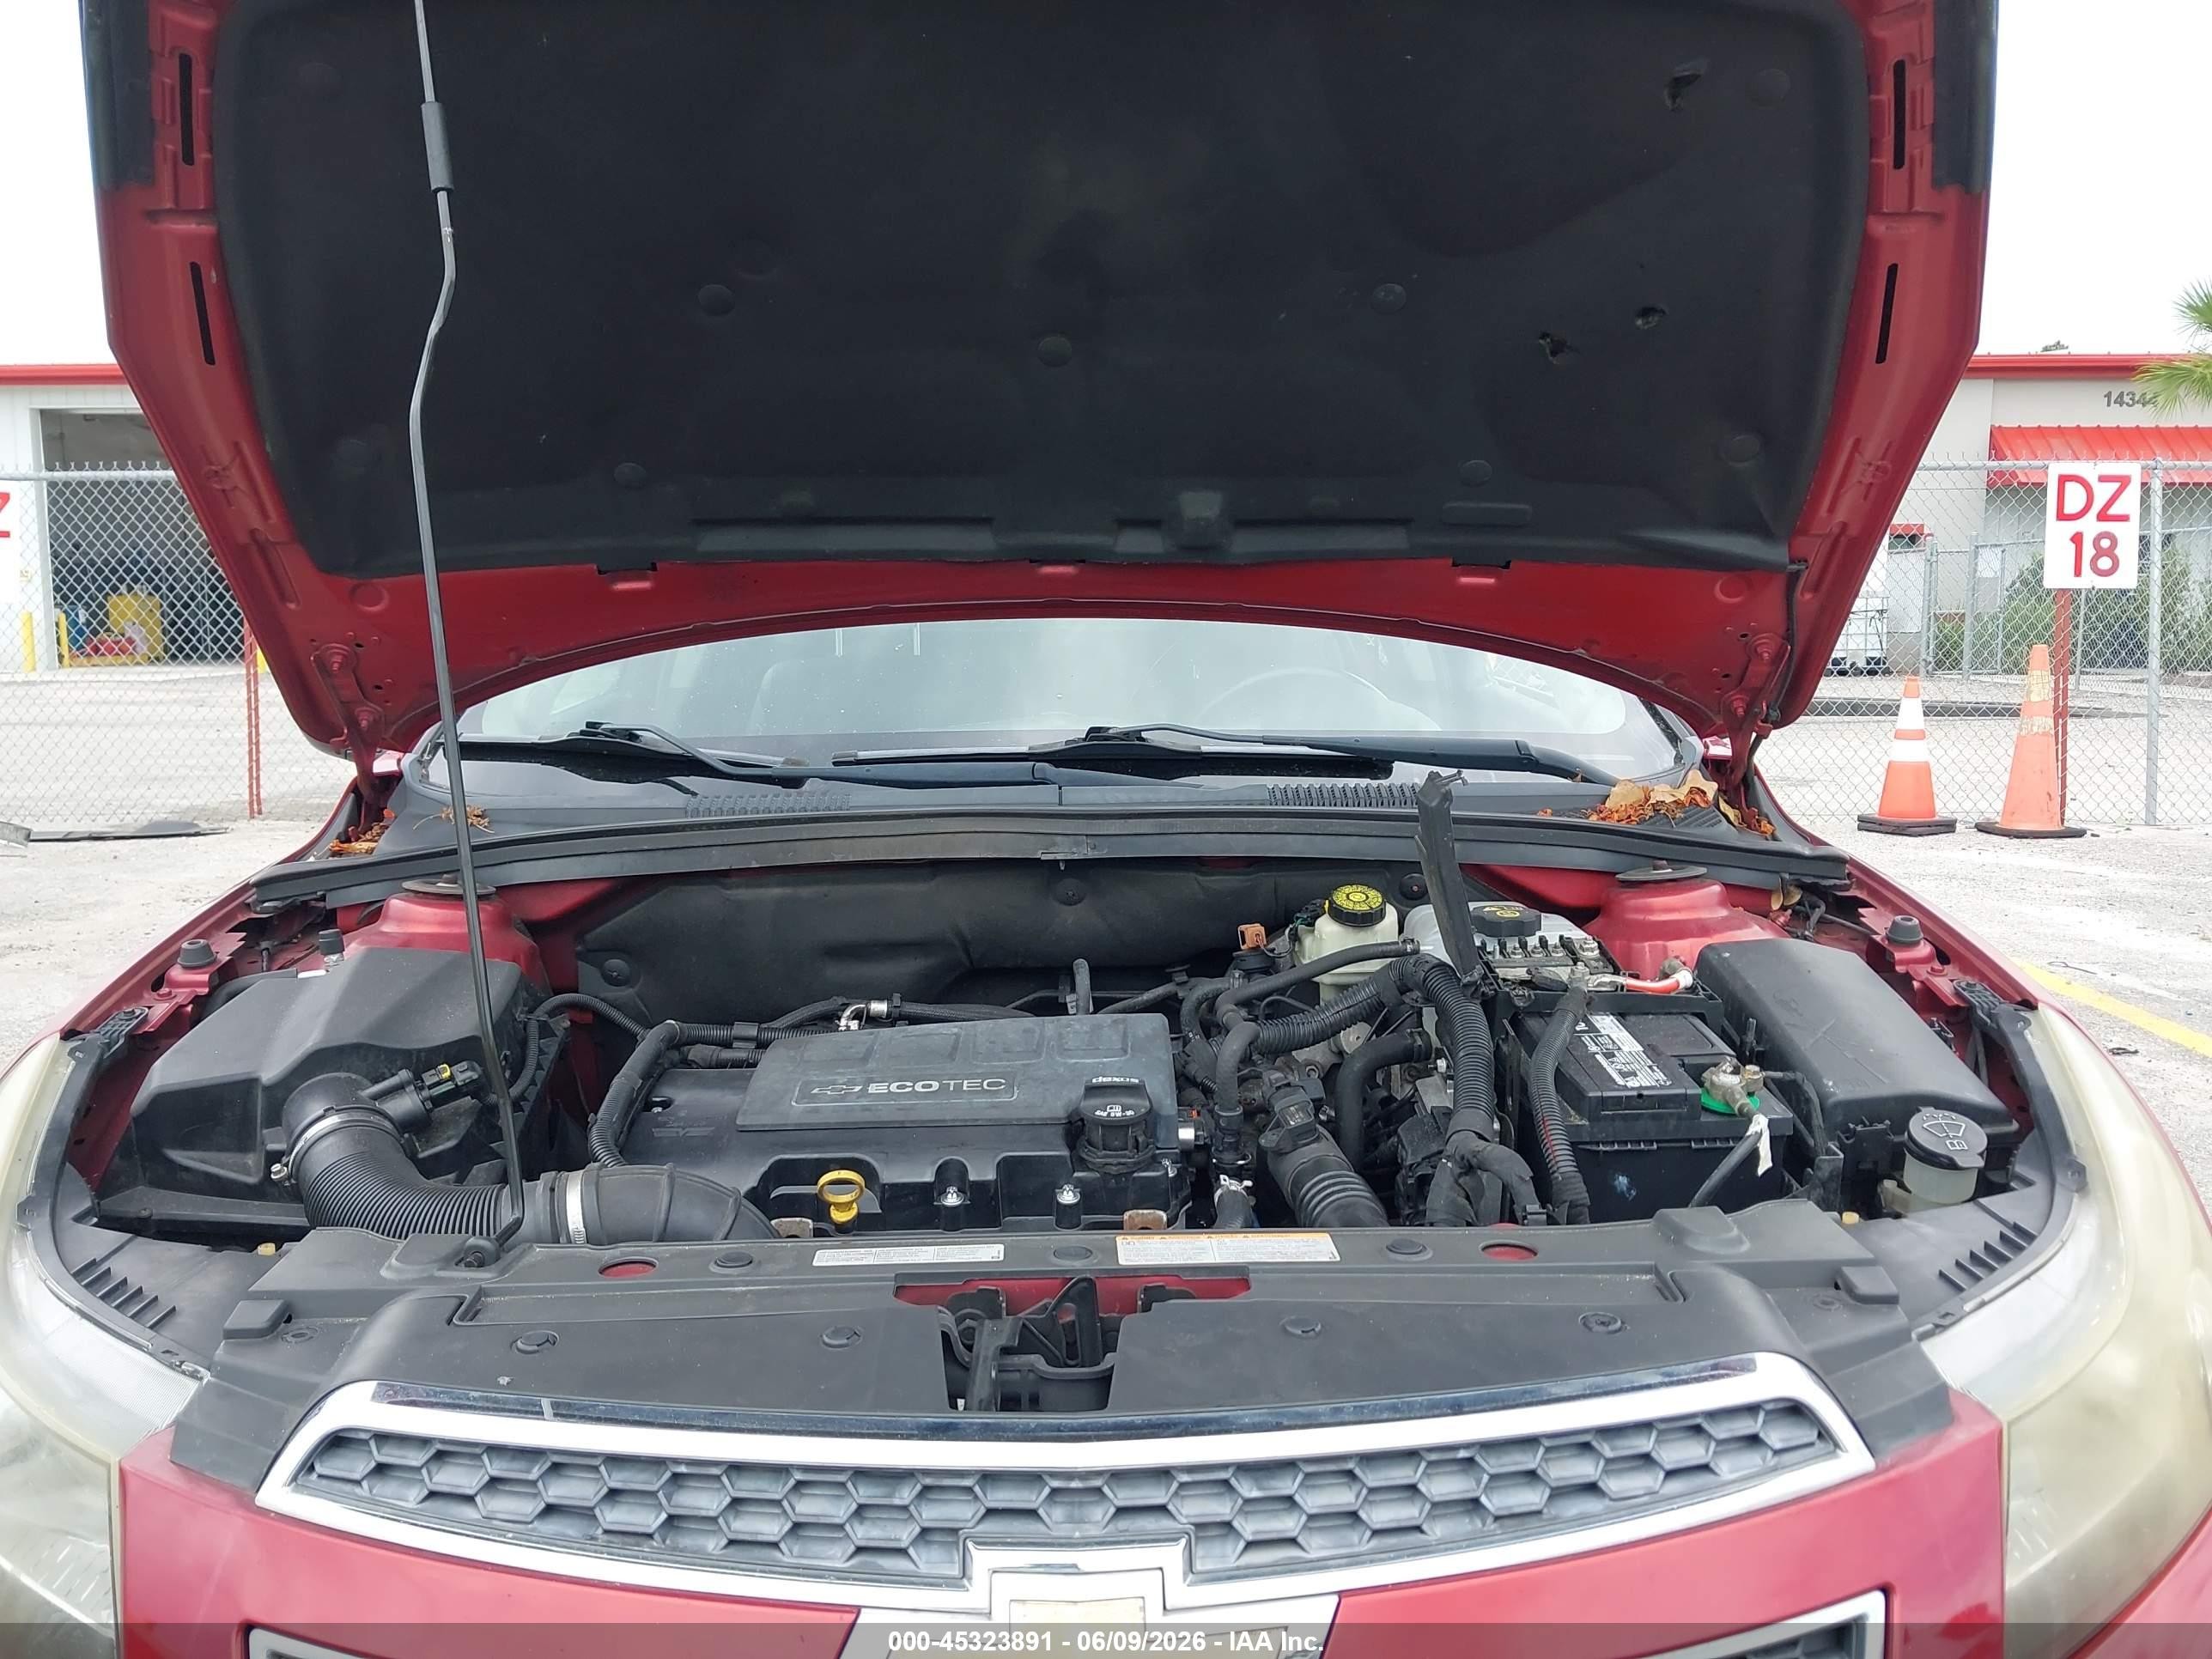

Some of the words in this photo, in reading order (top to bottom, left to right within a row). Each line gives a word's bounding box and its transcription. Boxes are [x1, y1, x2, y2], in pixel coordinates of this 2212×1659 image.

[2056, 474, 2132, 522] DZ
[2069, 531, 2120, 578] 18
[867, 1079, 1006, 1094] ECOTEC
